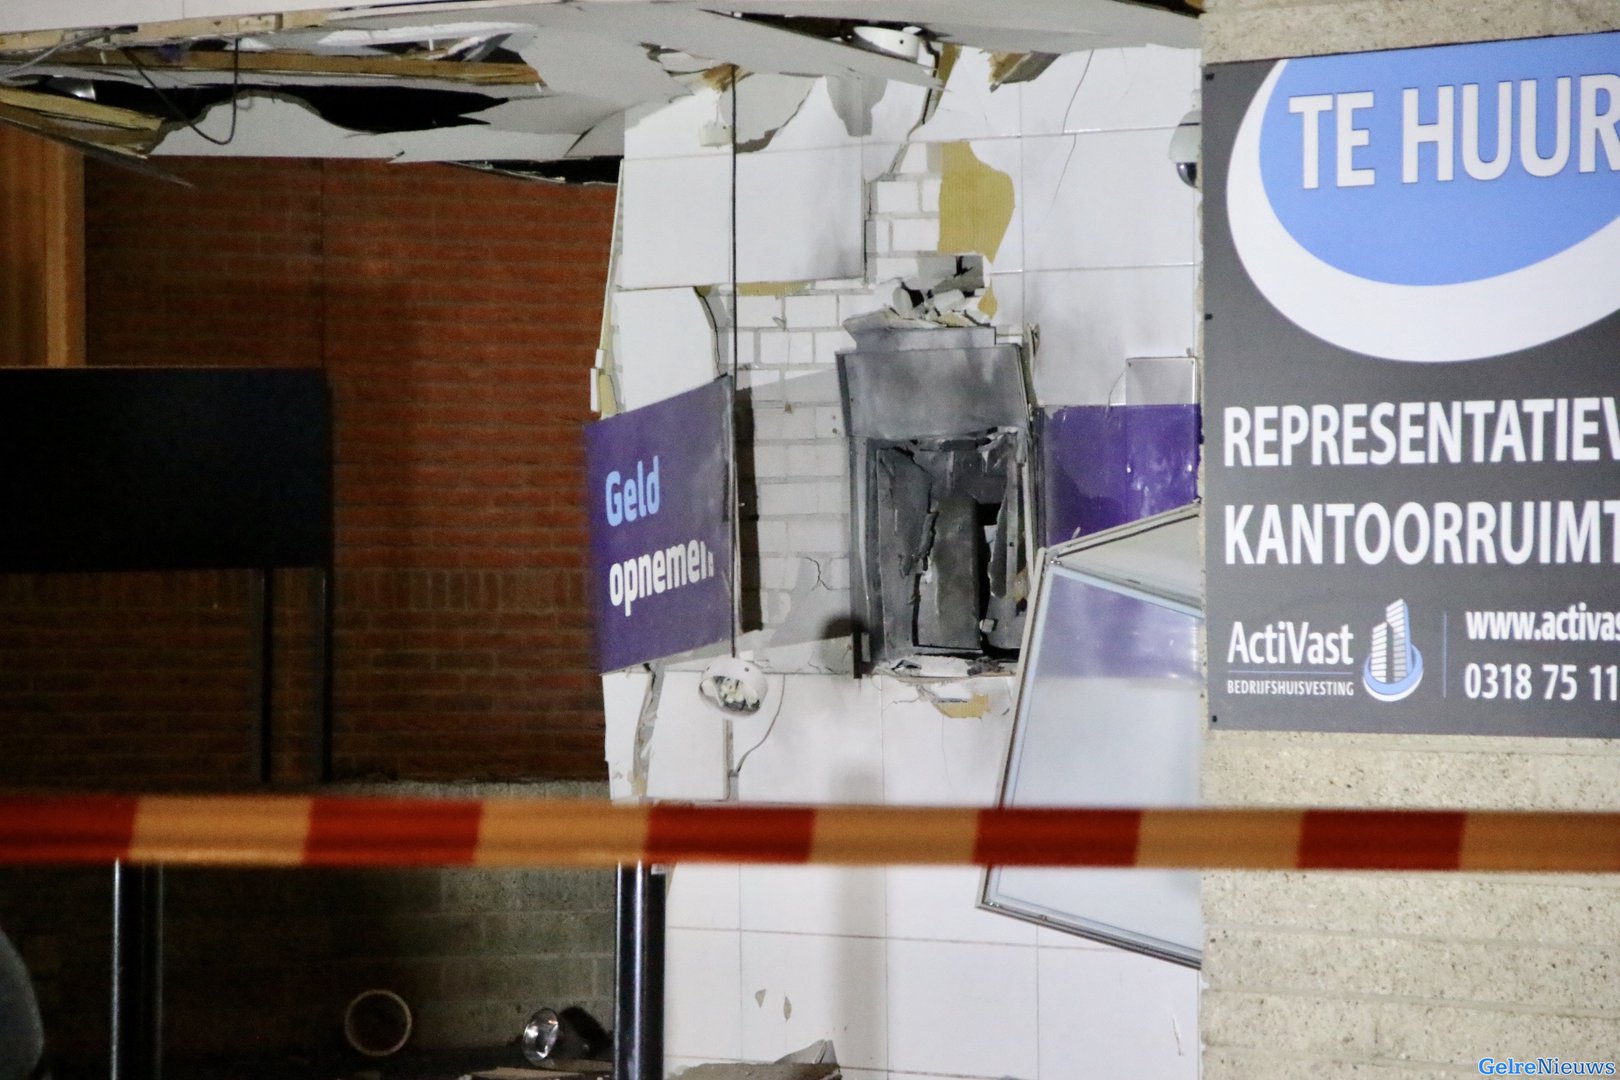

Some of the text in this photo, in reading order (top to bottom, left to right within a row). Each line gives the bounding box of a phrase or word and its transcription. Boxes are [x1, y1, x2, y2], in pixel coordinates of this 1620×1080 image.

[1288, 73, 1620, 190] TE HUUR
[606, 455, 660, 527] Geld
[1227, 621, 1354, 665] ActiVast
[1227, 679, 1355, 696] BEDRIJFSHUISVESTING
[1464, 662, 1618, 702] 0318 75 11
